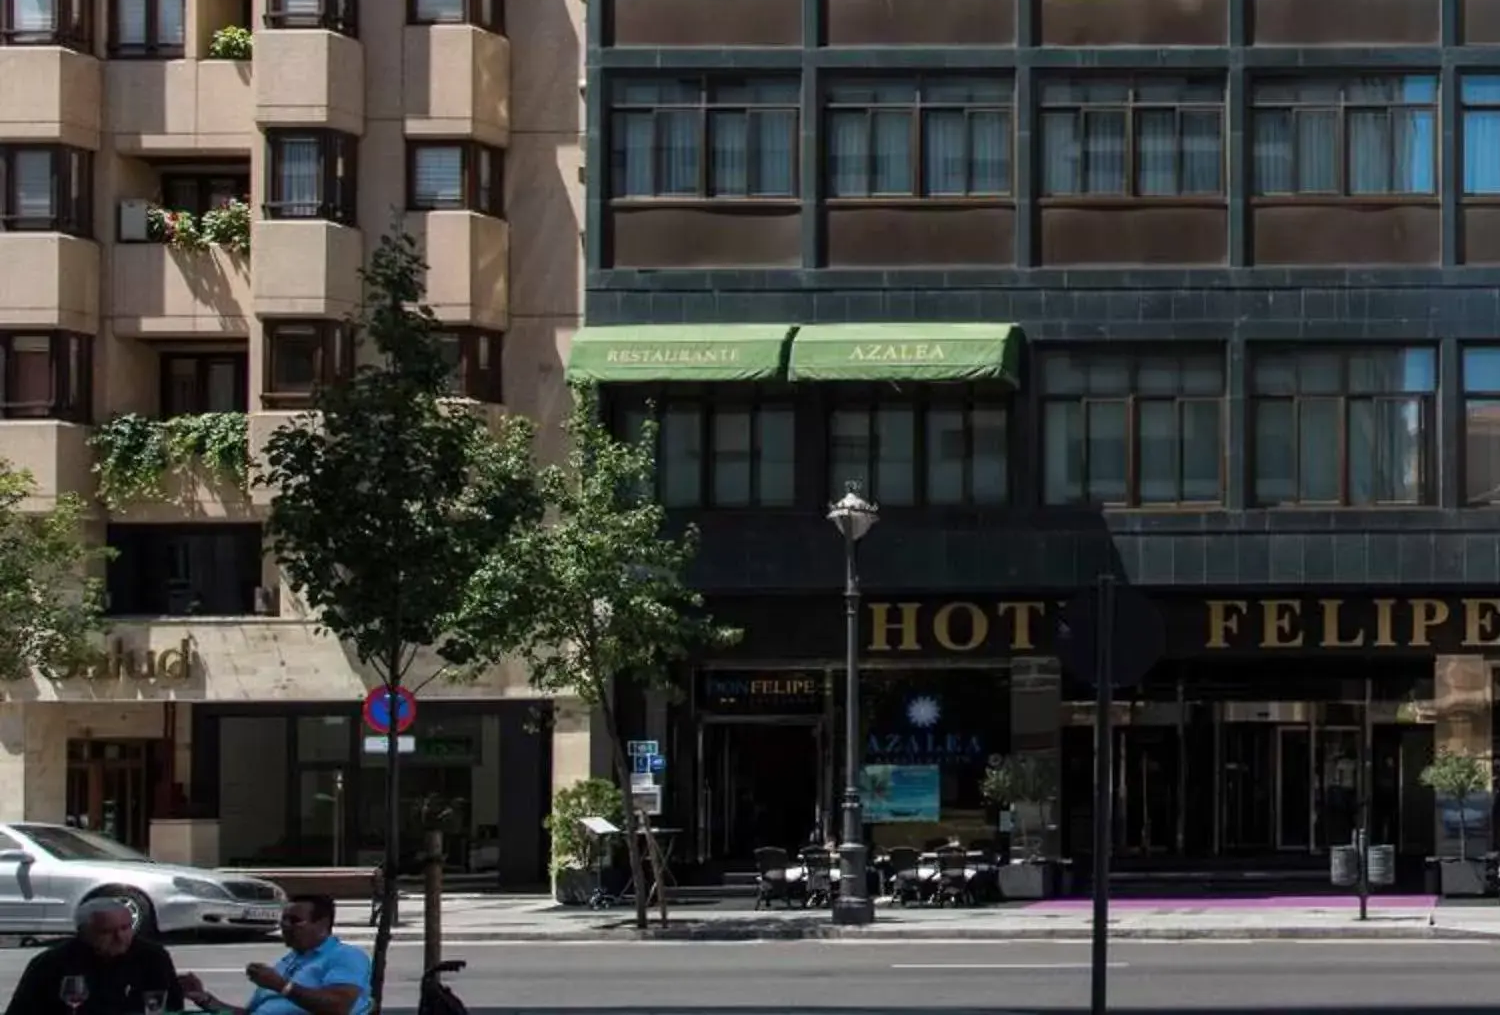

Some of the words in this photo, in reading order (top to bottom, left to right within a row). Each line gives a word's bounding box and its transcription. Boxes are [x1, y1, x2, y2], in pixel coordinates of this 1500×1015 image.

[606, 347, 740, 363] RESTAURANTE
[847, 344, 945, 360] AZALEA
[868, 601, 1074, 651] HOT
[867, 732, 982, 753] AZALEA
